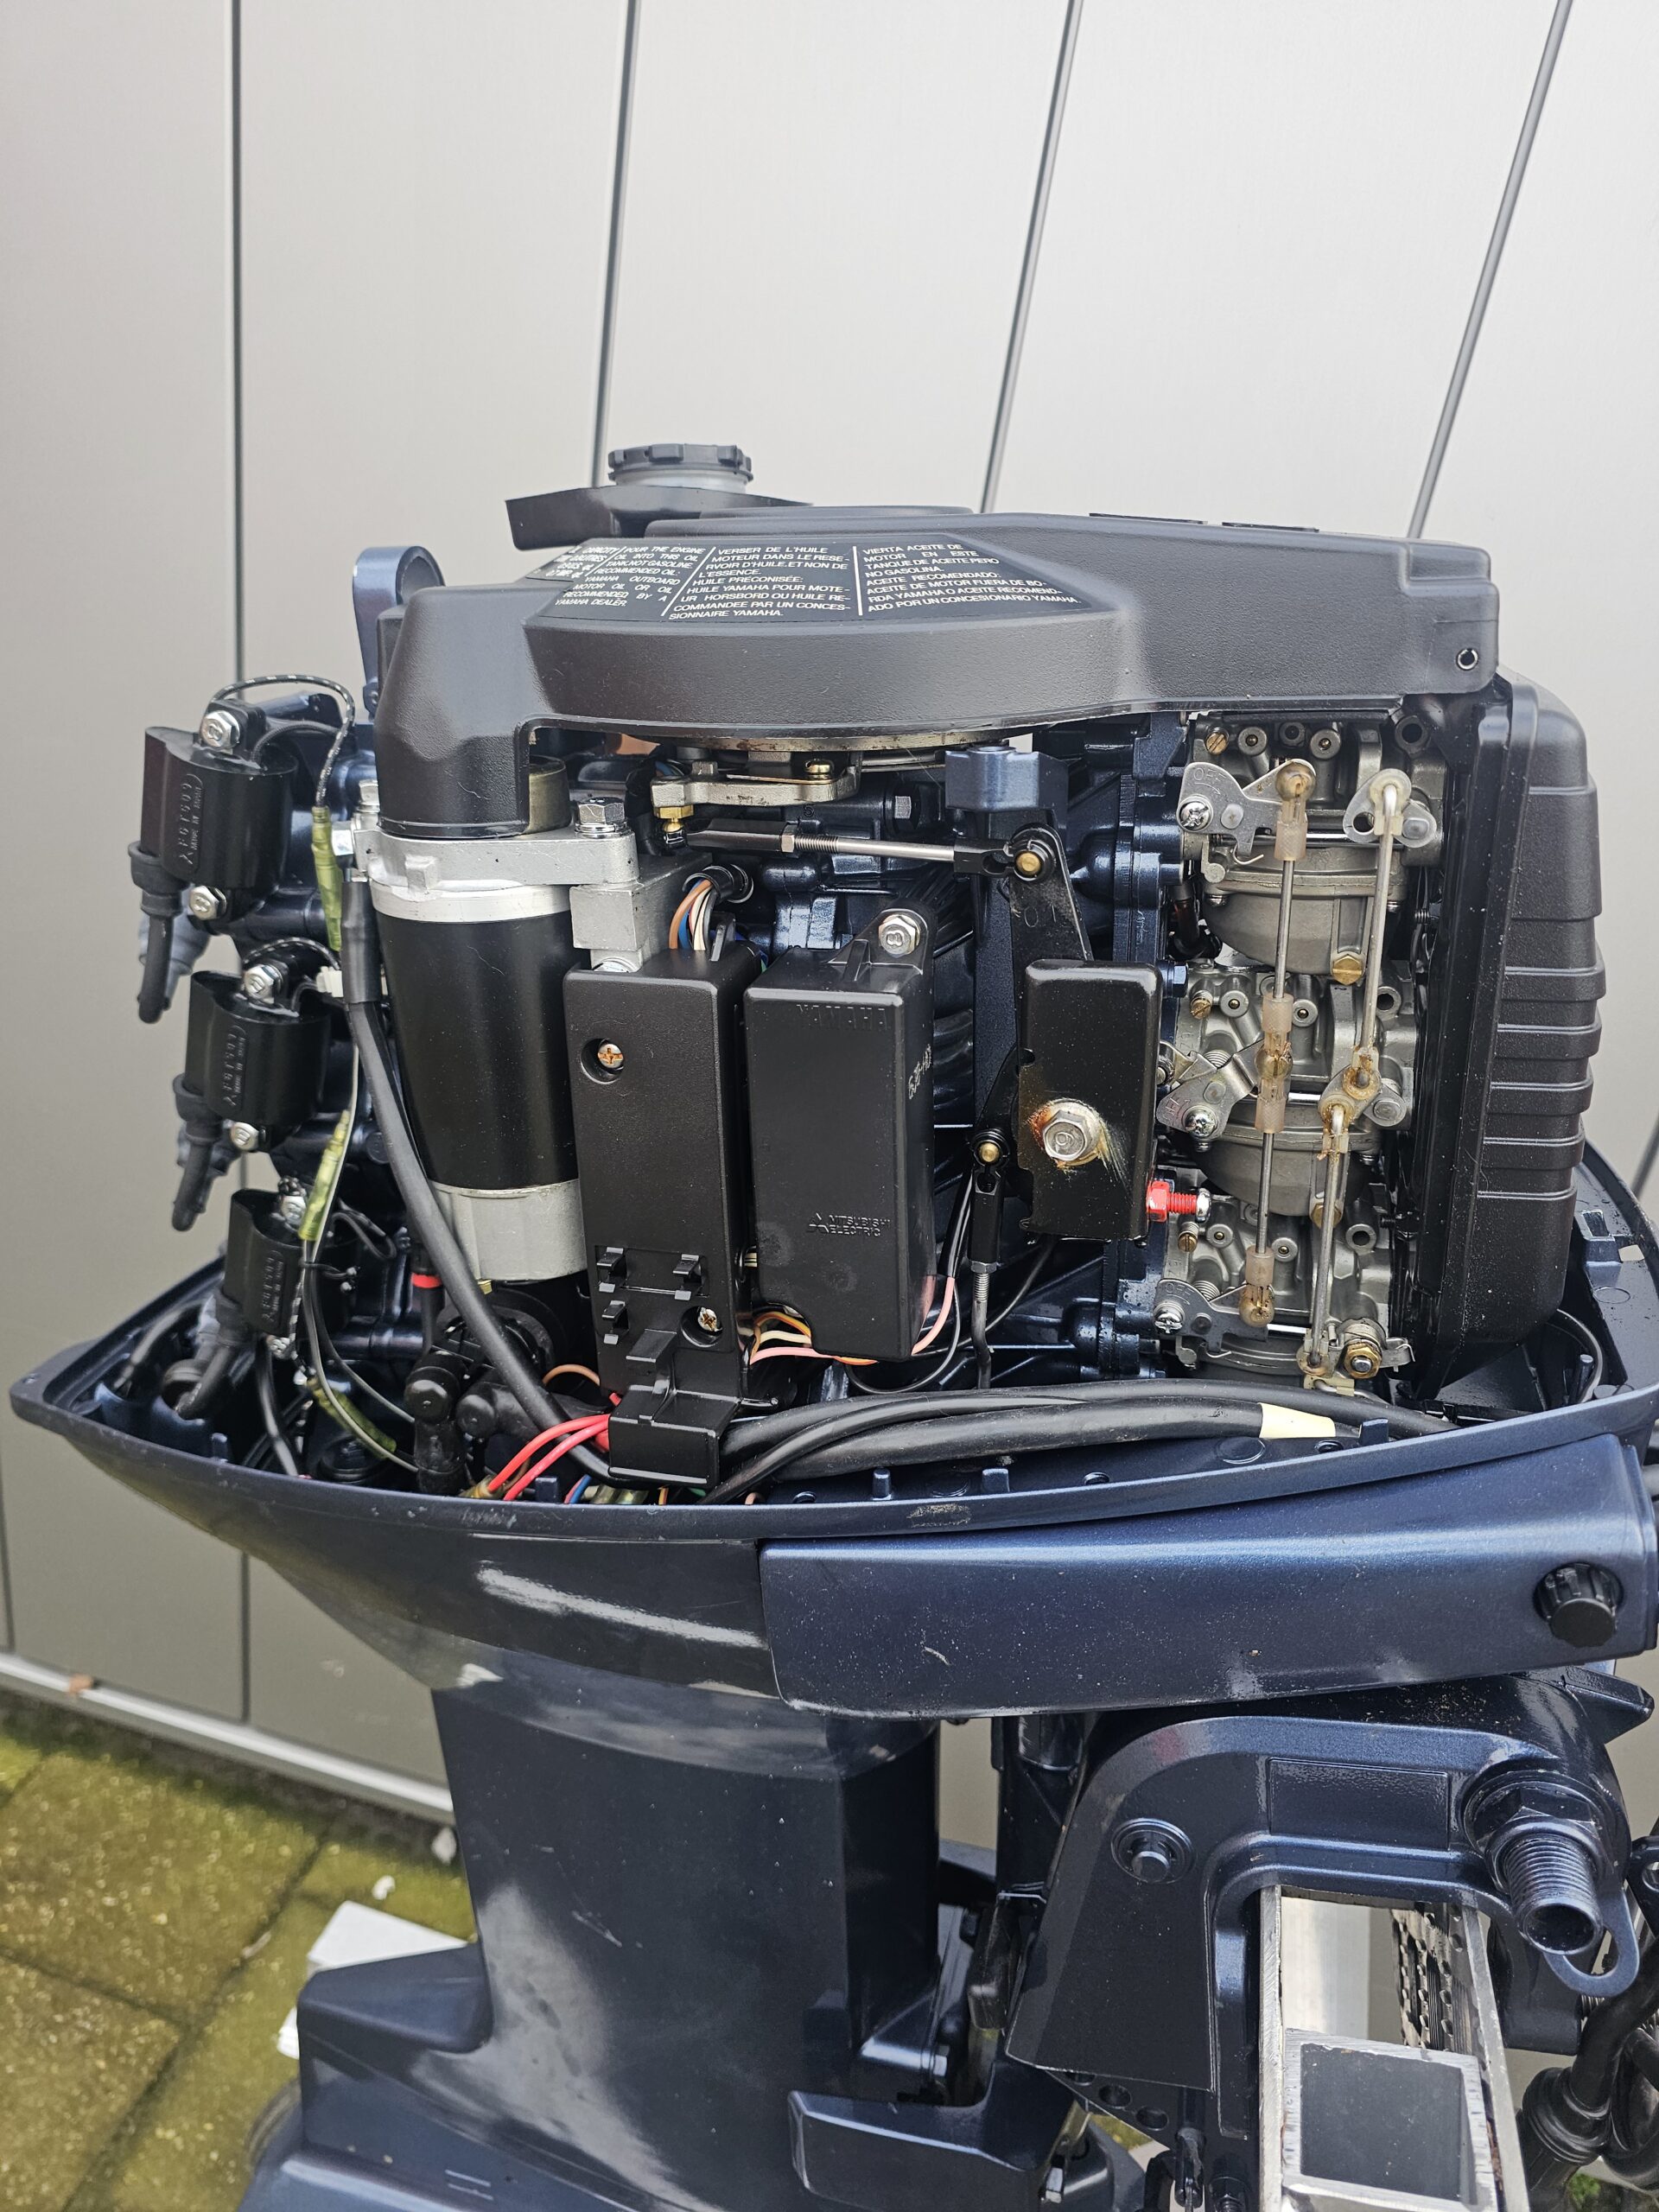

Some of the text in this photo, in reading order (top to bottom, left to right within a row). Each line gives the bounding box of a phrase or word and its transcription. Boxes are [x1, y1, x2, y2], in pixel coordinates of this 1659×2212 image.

[864, 554, 906, 563] MOTOR
[865, 561, 912, 569] TANQUE
[885, 566, 944, 575] GASOLINA.
[629, 576, 680, 585] OUTBOARD
[867, 572, 1001, 586] ACEITE RECOMENDADO:
[868, 584, 908, 594] ACEITE
[894, 589, 945, 599] YAMAHA
[669, 611, 729, 620] SIONNAIRE
[830, 1214, 891, 1227] MITSUBISHI
[829, 1224, 880, 1236] ELECTRIC
